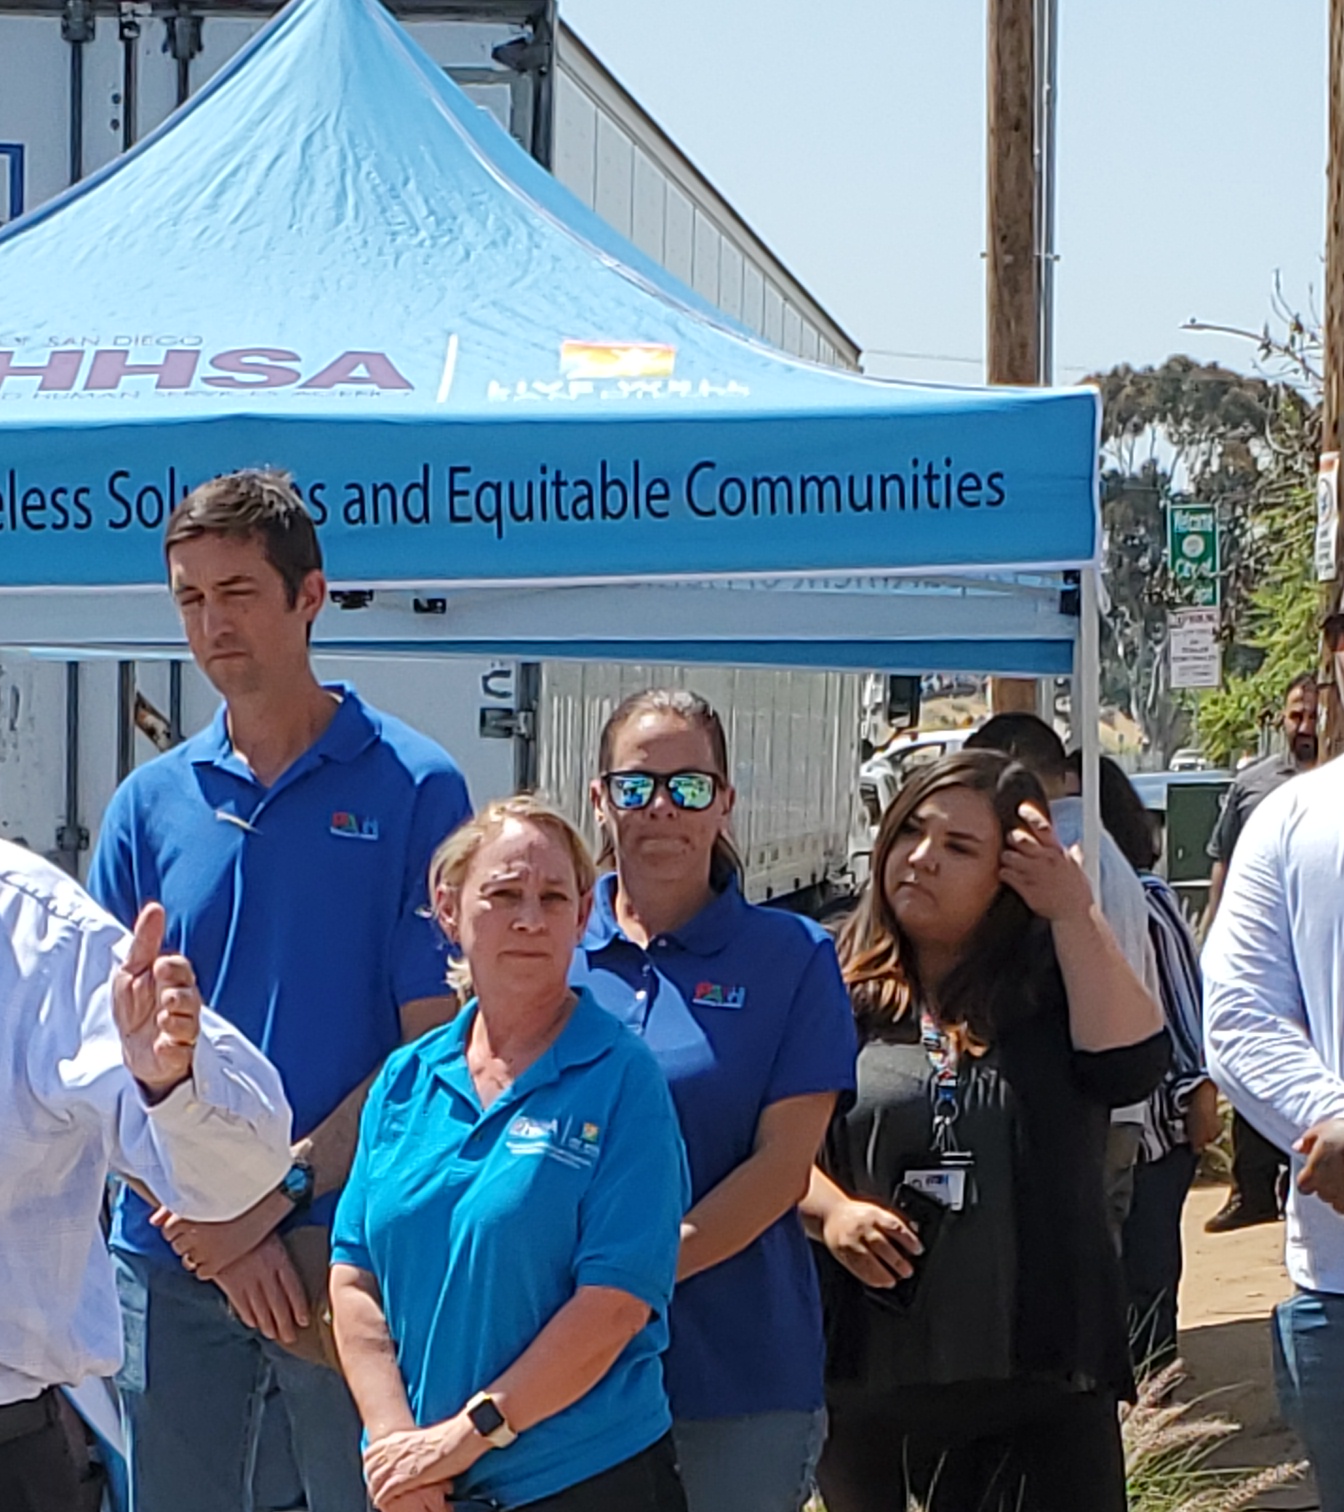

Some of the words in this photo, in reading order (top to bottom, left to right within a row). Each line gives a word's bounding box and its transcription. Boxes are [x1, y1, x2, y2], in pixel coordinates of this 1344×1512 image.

[47, 335, 100, 347] SAN
[113, 334, 204, 347] DIEGO
[32, 390, 139, 401] HUMAN
[343, 464, 430, 527] and
[448, 458, 671, 539] Equitable
[684, 457, 1006, 519] Communities
